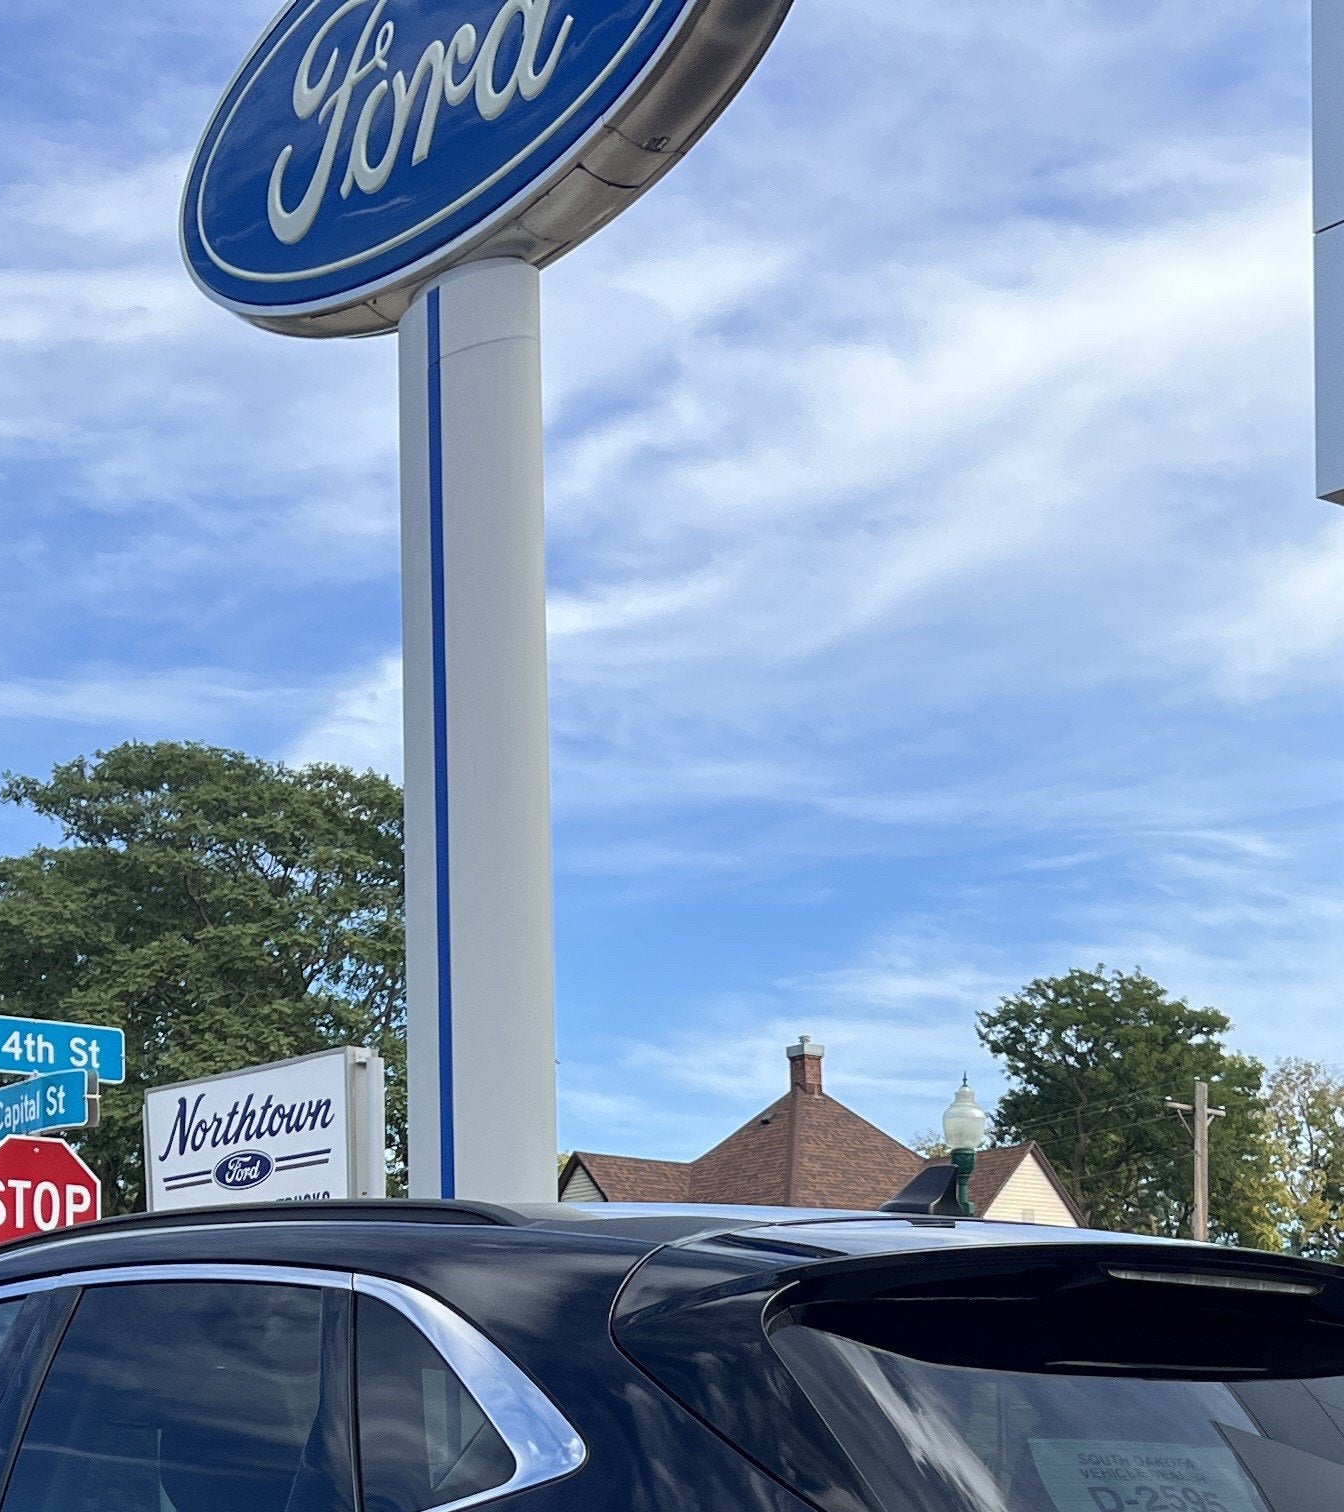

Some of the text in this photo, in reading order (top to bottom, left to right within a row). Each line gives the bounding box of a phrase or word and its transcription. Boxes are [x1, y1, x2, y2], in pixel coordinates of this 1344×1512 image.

[267, 0, 574, 244] Ford
[1, 1034, 55, 1064] 4th
[69, 1037, 102, 1069] St
[45, 1085, 66, 1116] St
[159, 1093, 335, 1161] Northtown
[225, 1155, 260, 1183] Ford
[1077, 1452, 1129, 1467] SOUTH
